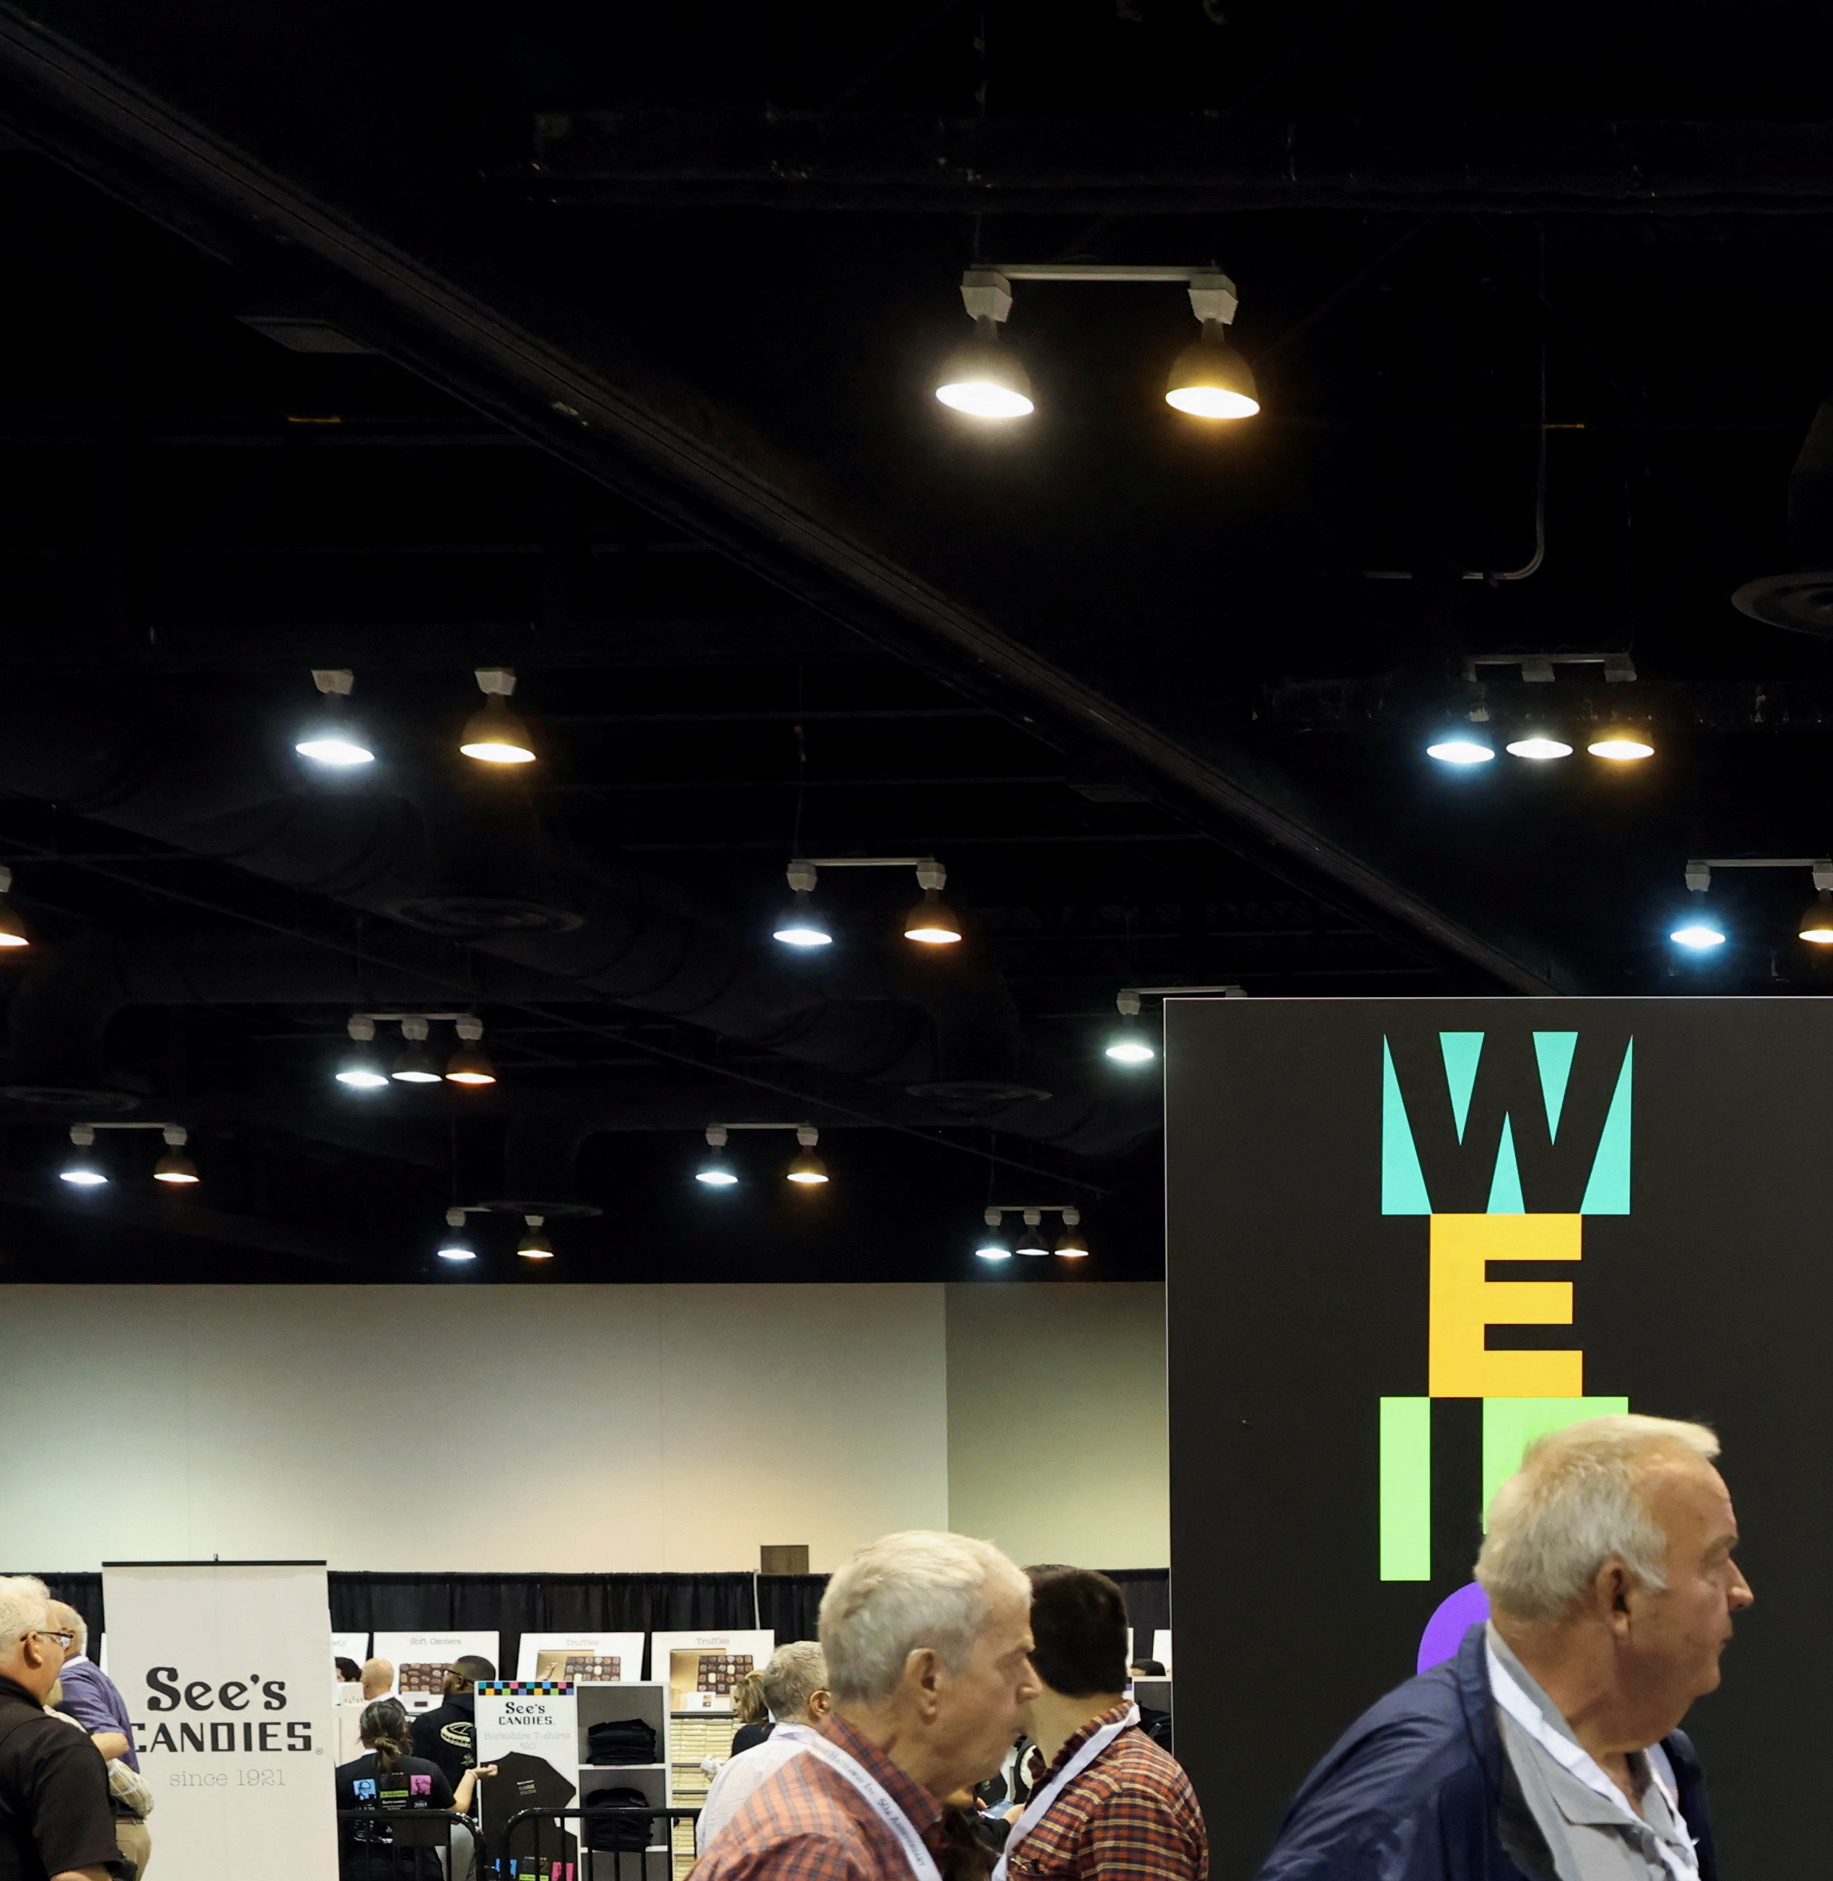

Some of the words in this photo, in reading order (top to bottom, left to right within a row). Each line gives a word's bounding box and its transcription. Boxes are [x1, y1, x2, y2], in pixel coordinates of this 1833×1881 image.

[145, 1666, 288, 1712] See's
[504, 1701, 547, 1715] See's
[169, 1769, 229, 1787] since
[237, 1768, 287, 1787] 1921
